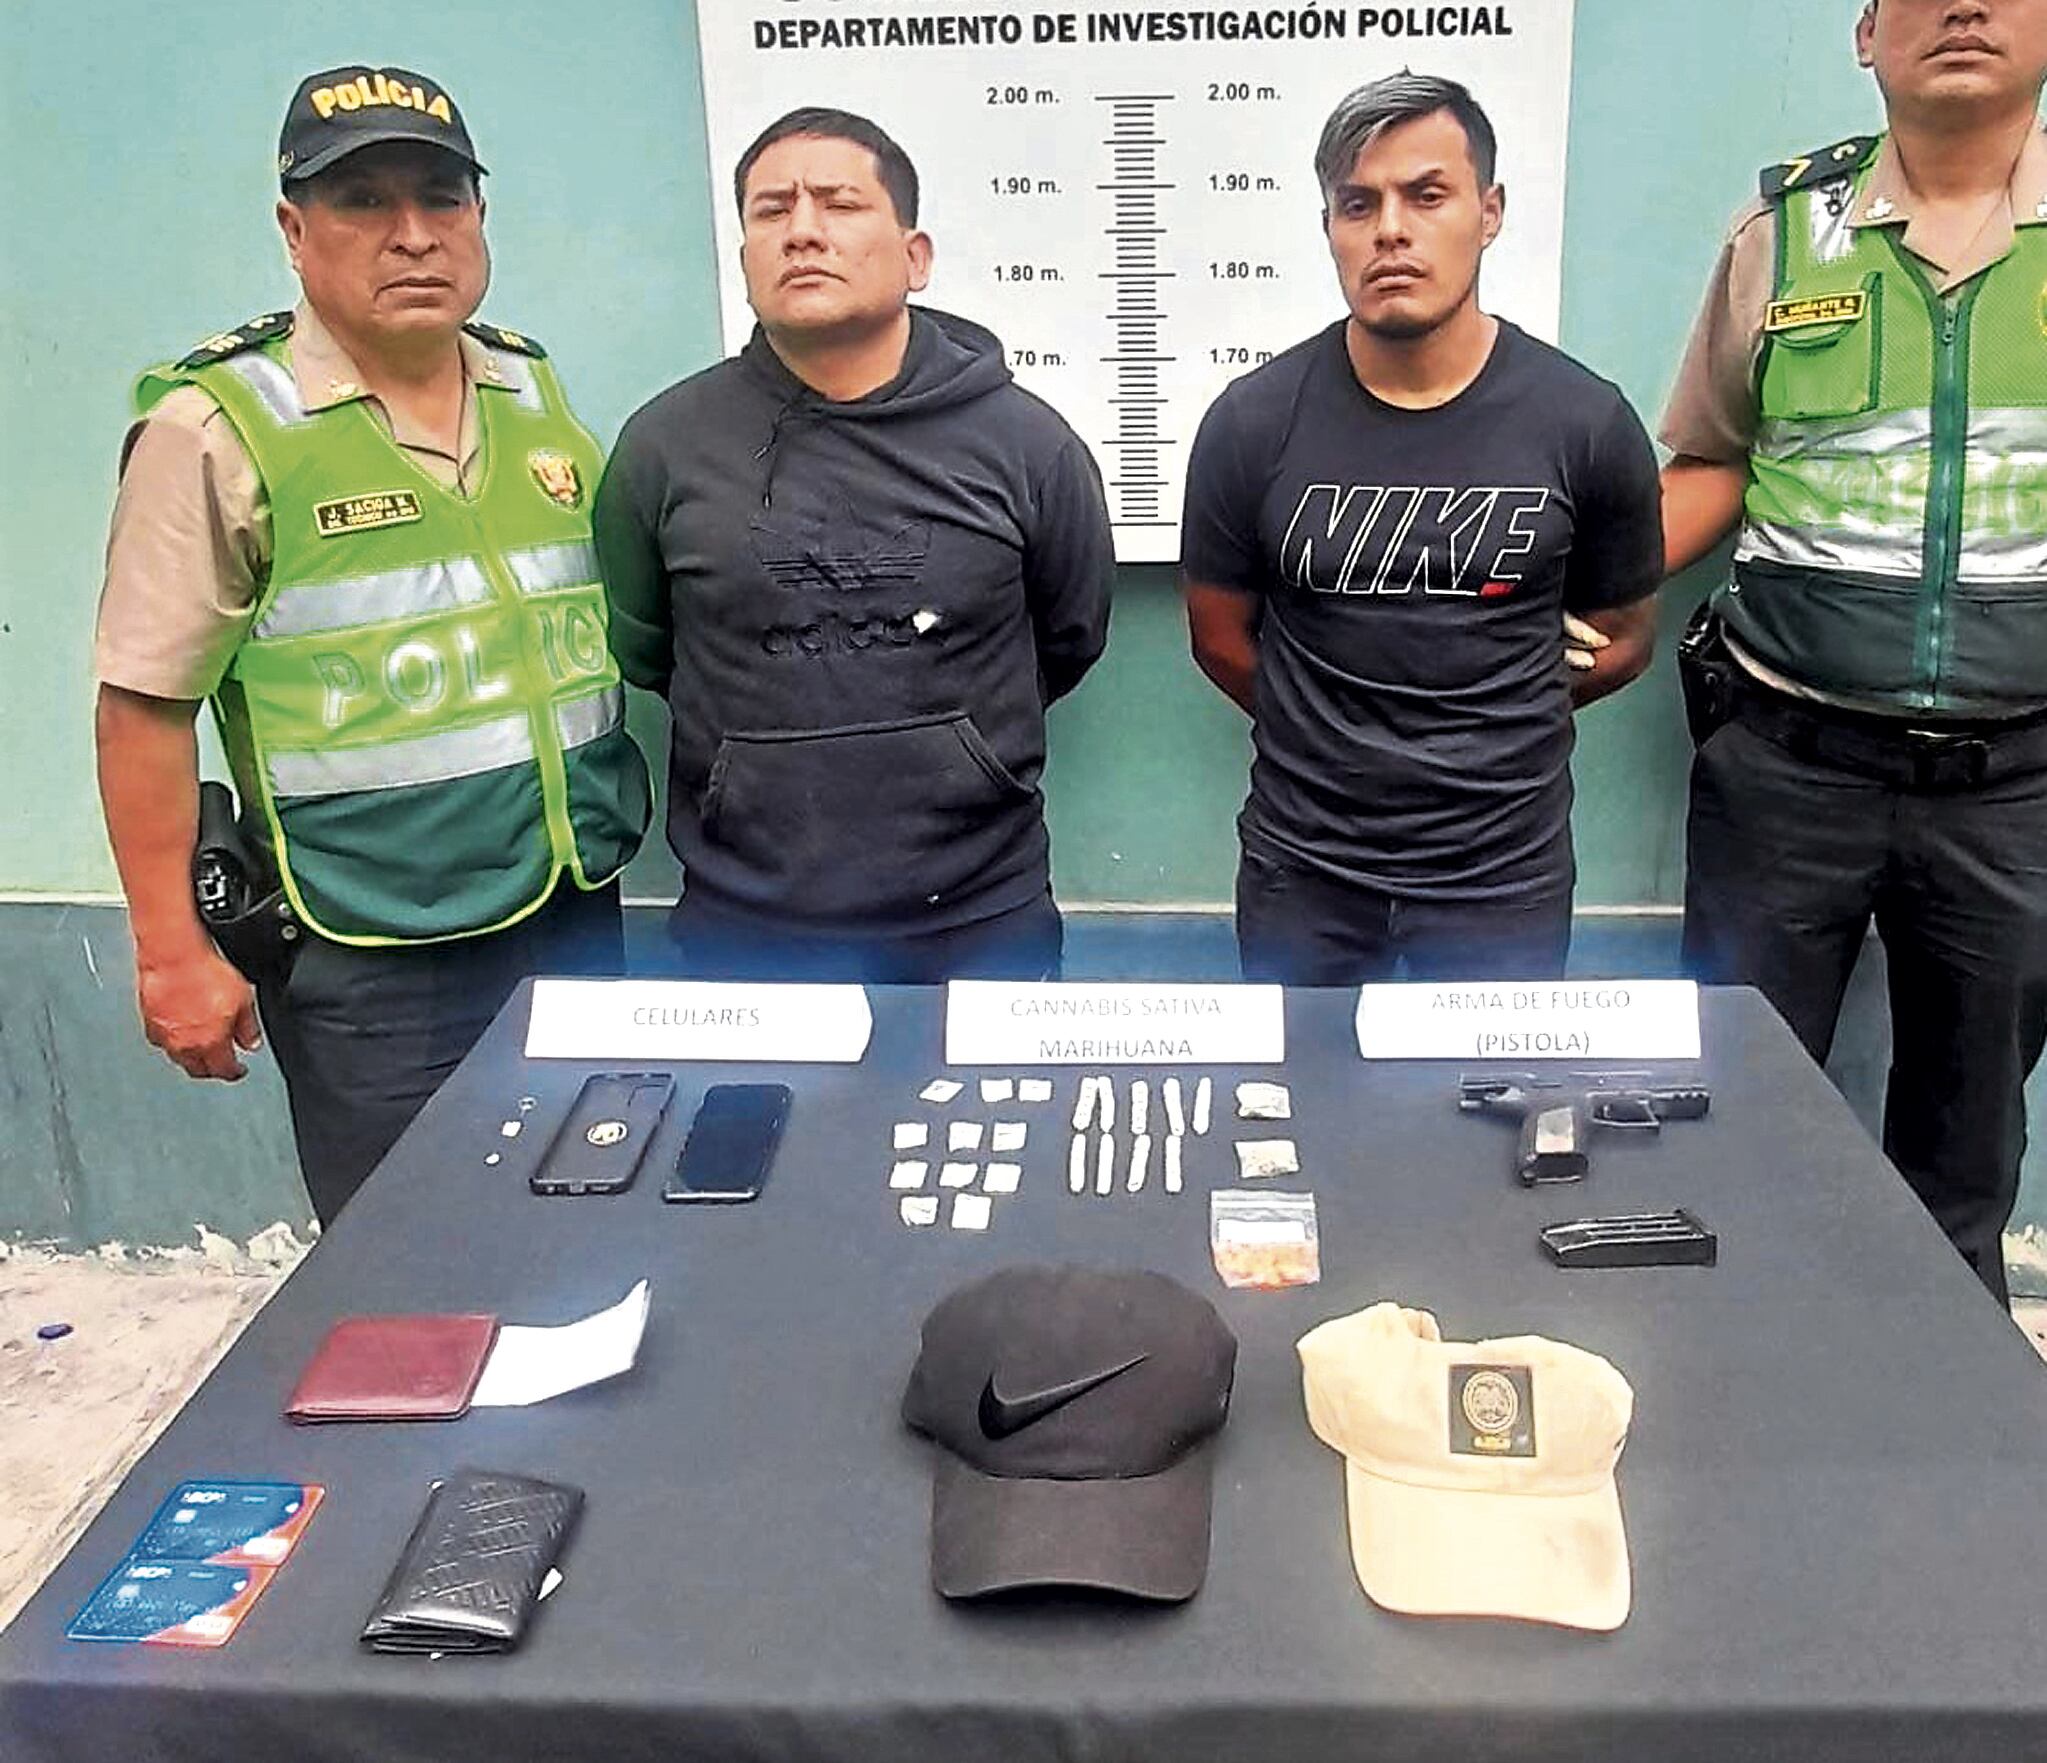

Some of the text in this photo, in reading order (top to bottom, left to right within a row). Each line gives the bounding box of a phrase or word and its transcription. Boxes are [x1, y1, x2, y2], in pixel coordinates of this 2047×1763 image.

[754, 3, 1513, 49] DEPARTAMENTO DE INVESTIGACIÓN POLICIAL
[310, 74, 452, 125] POLICIA
[986, 86, 1060, 105] 2.00 m.
[1208, 82, 1281, 101] 2.00 m.
[991, 177, 1062, 195] 1.90 m.
[1209, 173, 1281, 192] 1.90 m.
[994, 264, 1064, 282] 1.80 m.
[1209, 261, 1279, 279] 1.80 m.
[1009, 350, 1066, 366] .70 m.
[1210, 347, 1249, 365] 1.70
[1280, 484, 1550, 597] NIKE
[1010, 998, 1222, 1017] CANNABIS SATIVA
[1431, 988, 1632, 1011] ARMA DE FUEGO
[633, 1007, 760, 1027] CELULARES
[1039, 1039, 1193, 1060] MARIHUANA
[1476, 1030, 1591, 1058] (PISTOLA)
